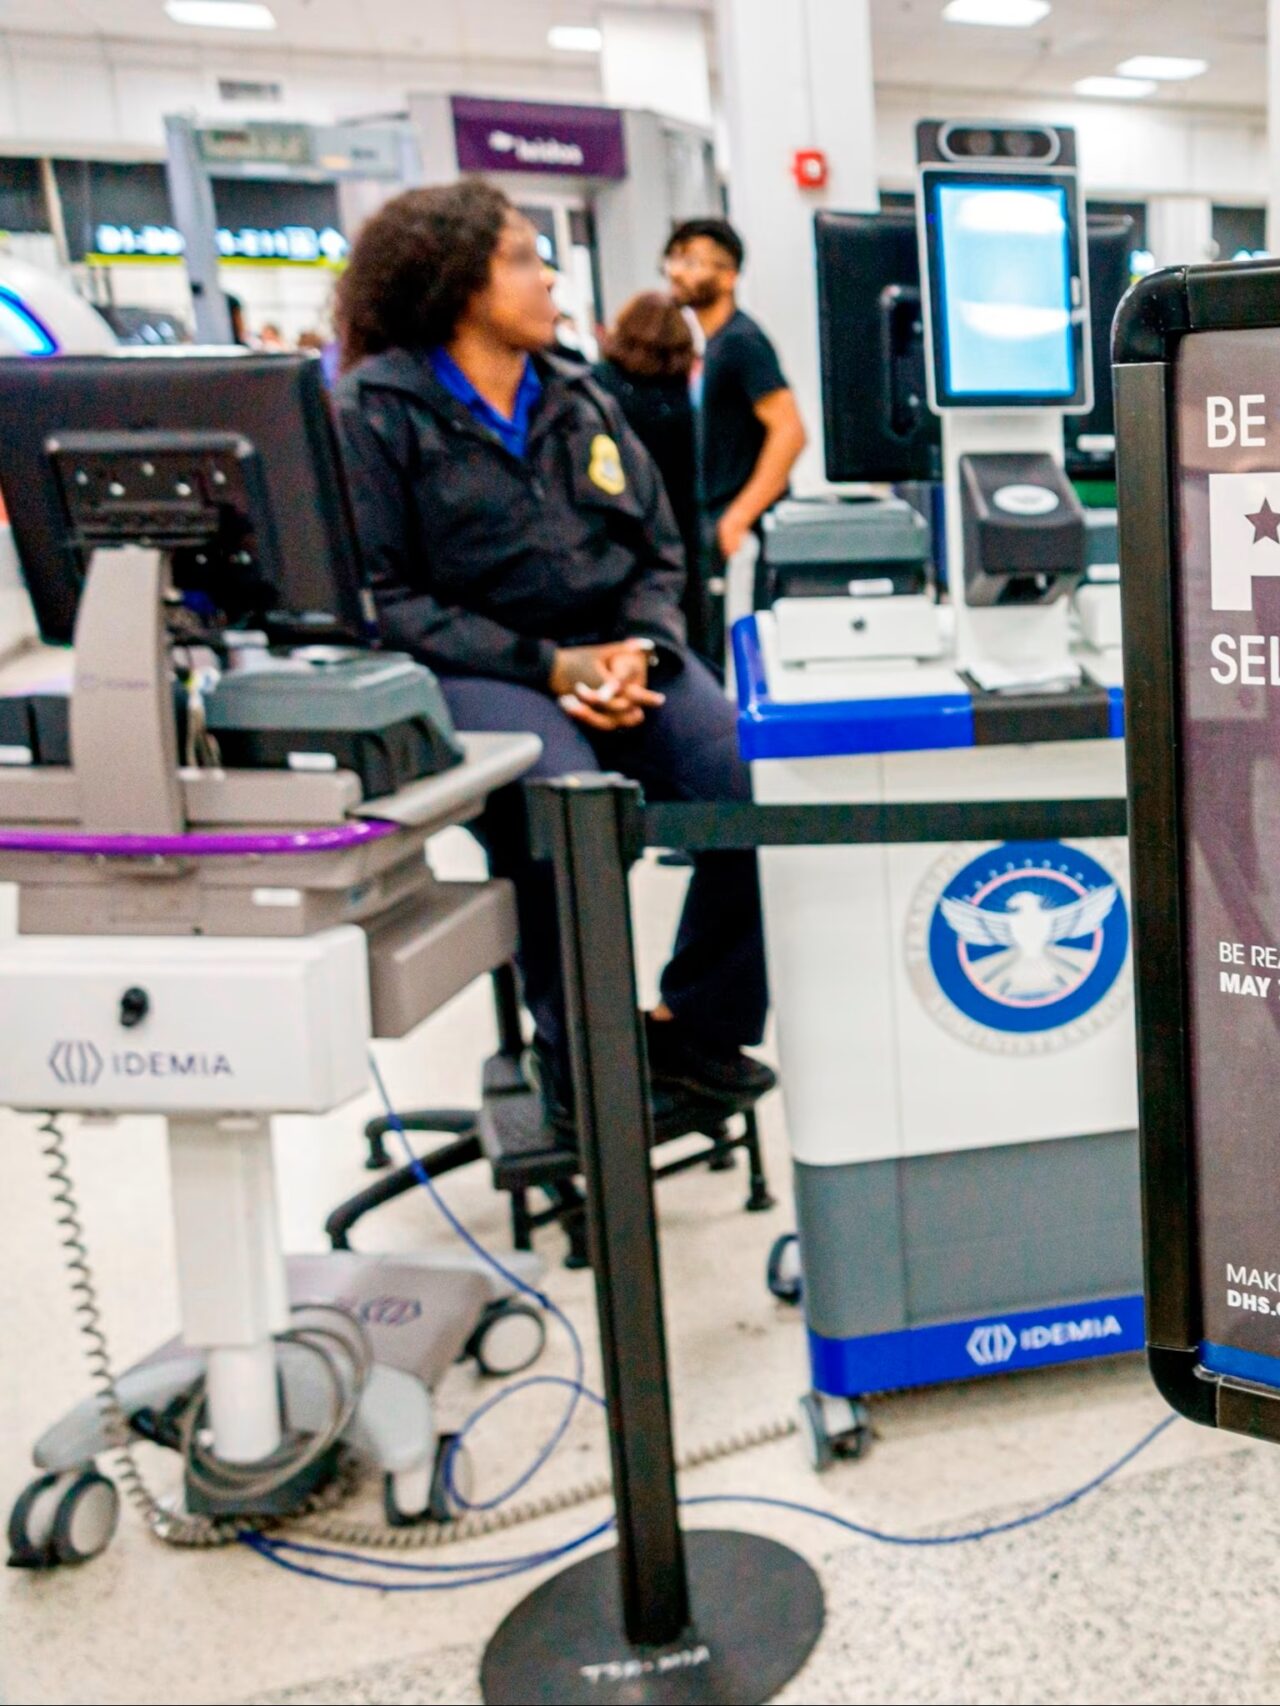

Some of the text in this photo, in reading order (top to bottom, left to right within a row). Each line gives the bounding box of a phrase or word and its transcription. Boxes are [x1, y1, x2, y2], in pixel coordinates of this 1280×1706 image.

[1207, 395, 1266, 447] BE
[1219, 941, 1245, 965] BE
[1219, 972, 1271, 997] MAY
[112, 1052, 234, 1076] IDEMIA
[1020, 1315, 1122, 1350] IDEMIA
